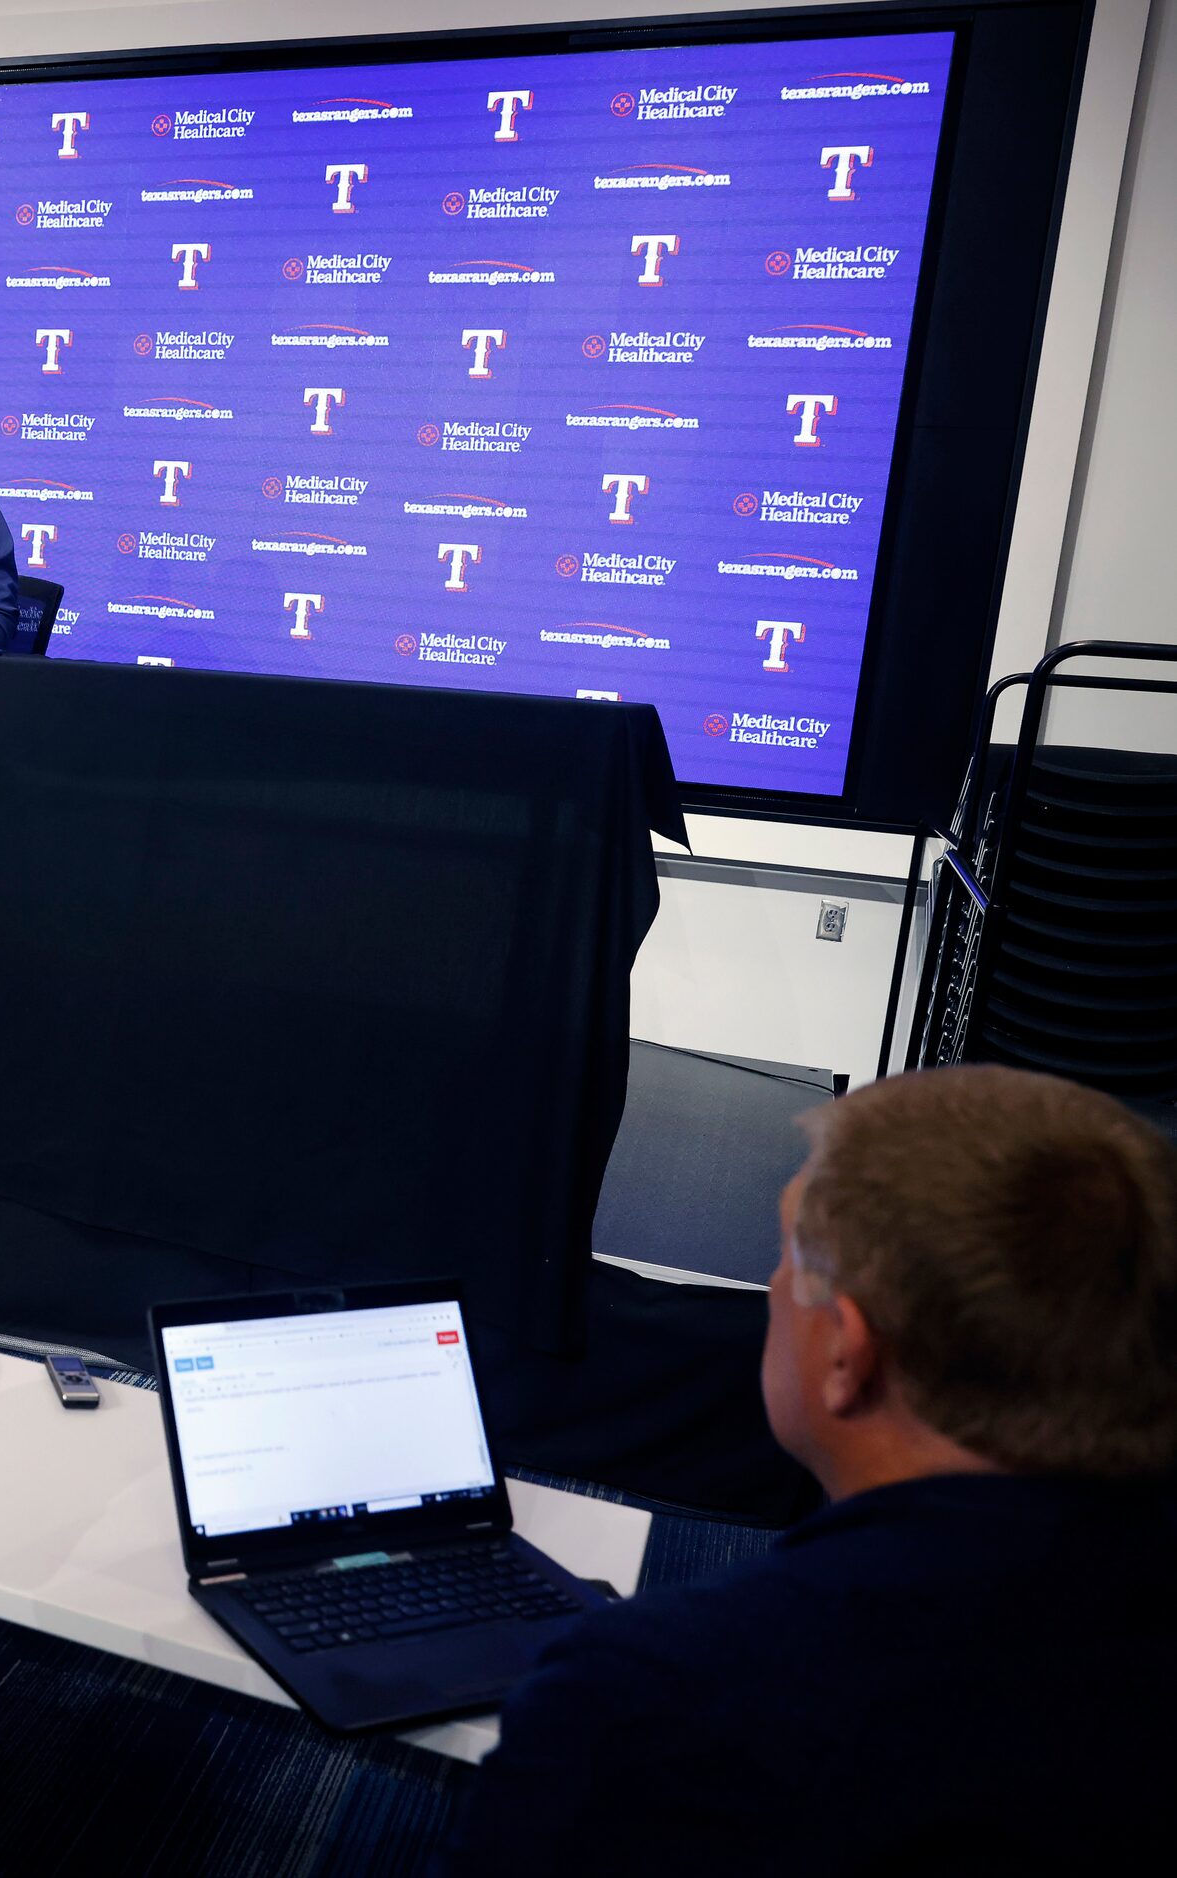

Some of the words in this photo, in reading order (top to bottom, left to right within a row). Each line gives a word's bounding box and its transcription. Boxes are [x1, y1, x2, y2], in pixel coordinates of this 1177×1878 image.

[638, 86, 702, 104] Medical
[703, 85, 738, 104] City
[781, 81, 930, 100] texasrangers.com
[174, 109, 226, 125] Medical
[228, 108, 255, 126] City
[292, 107, 413, 122] texasrangers.com
[487, 90, 534, 142] T
[52, 112, 90, 159] T
[594, 174, 731, 190] texasrangers.com
[820, 146, 874, 201] T
[141, 185, 253, 203] texasrangers.com
[325, 164, 368, 213] T
[469, 187, 527, 203] Medical
[528, 187, 560, 205] City
[37, 200, 85, 214] Medical
[87, 200, 112, 216] City
[307, 254, 361, 269] Medical
[363, 254, 392, 272] City
[631, 235, 680, 287] T
[794, 246, 862, 263] Medical
[863, 246, 899, 266] City
[172, 243, 212, 290] T
[6, 276, 110, 289] texasrangers.com
[428, 271, 555, 285] texasrangers.com
[156, 331, 206, 345] Medical
[208, 332, 234, 348] City
[271, 334, 389, 348] texasrangers.com
[609, 332, 671, 346] Medical
[672, 332, 706, 350] City
[748, 335, 892, 351] texasrangers.com
[36, 329, 73, 374] T
[462, 330, 507, 379] T
[123, 406, 233, 420] texasrangers.com
[304, 388, 345, 435] T
[786, 395, 838, 447] T
[22, 414, 68, 426] Medical
[70, 415, 95, 430] City
[443, 422, 500, 436] Medical
[502, 423, 532, 441] City
[566, 414, 699, 430] texasrangers.com
[153, 461, 193, 506] T
[285, 476, 338, 490] Medical
[340, 478, 368, 494] City
[602, 474, 649, 524] T
[762, 491, 827, 507] Medical
[828, 494, 863, 512] City
[404, 502, 527, 518] texasrangers.com
[21, 524, 57, 568] T
[139, 532, 188, 546] Medical
[190, 534, 216, 551] City
[252, 539, 367, 555] texasrangers.com
[438, 543, 482, 592] T
[582, 553, 642, 569] Medical
[644, 556, 676, 574] City
[718, 561, 858, 580] texasrangers.com
[56, 609, 81, 625] City
[108, 602, 214, 619] texasrangers.com
[284, 593, 325, 640] T
[420, 633, 475, 649] Medical
[478, 637, 507, 655] City
[540, 630, 670, 649] texasrangers.com
[755, 620, 806, 672] T
[732, 713, 795, 731] Medical
[796, 718, 830, 737] City
